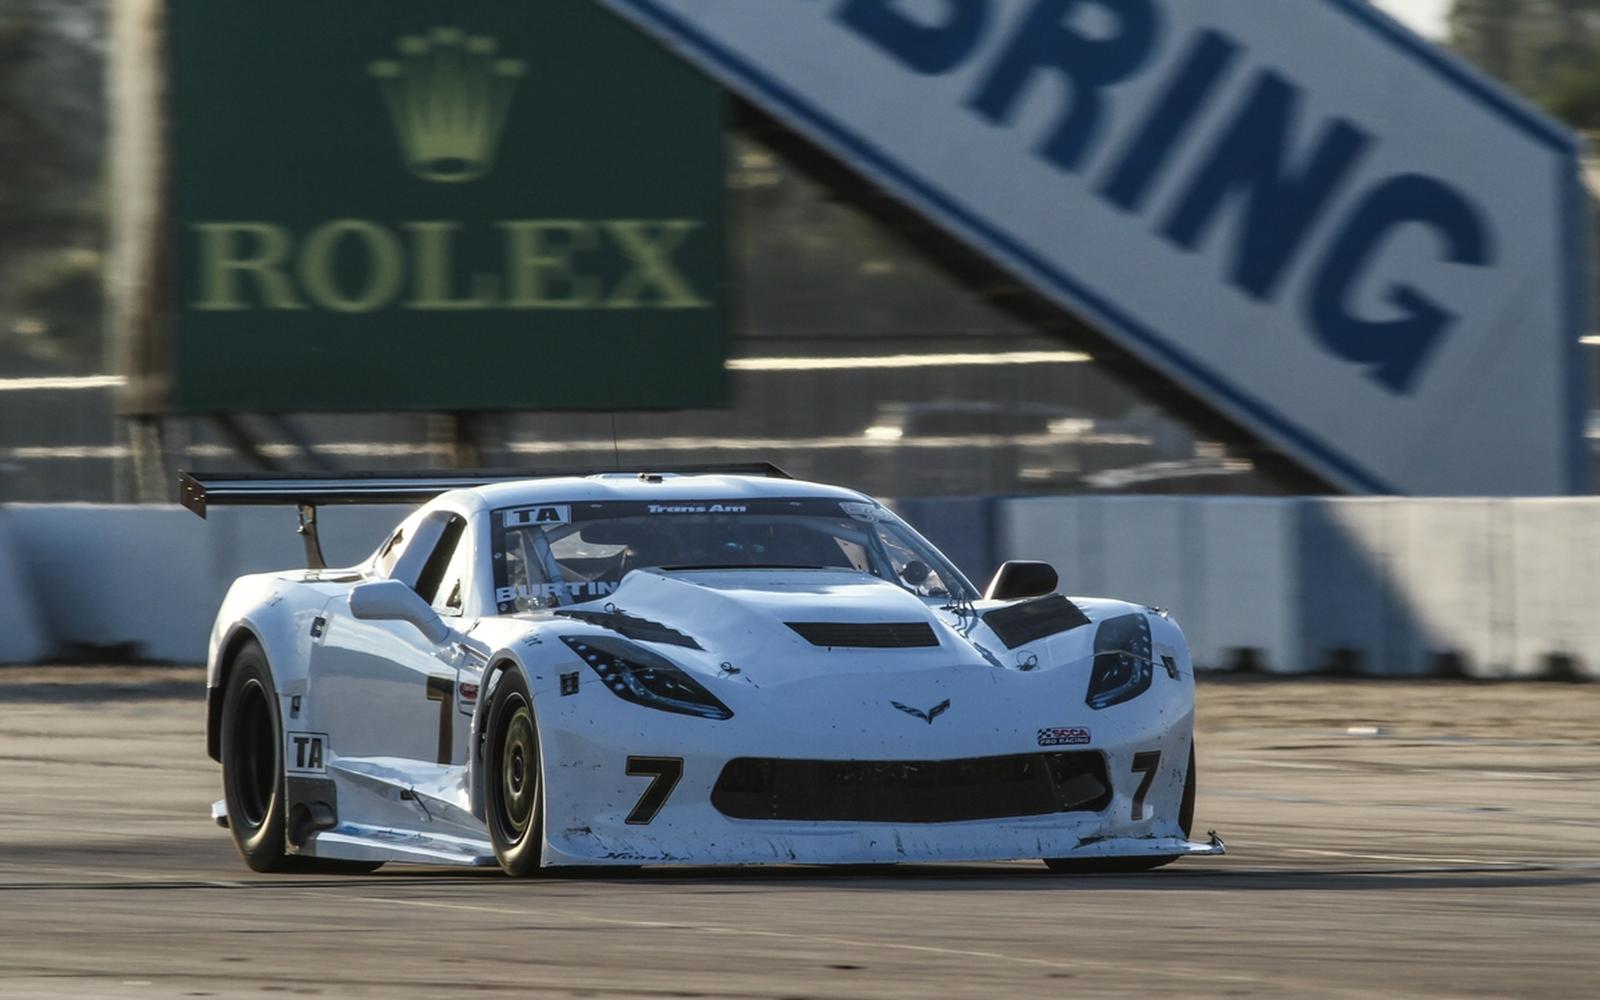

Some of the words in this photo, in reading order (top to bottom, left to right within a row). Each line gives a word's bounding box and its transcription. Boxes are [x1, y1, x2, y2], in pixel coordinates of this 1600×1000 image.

[190, 217, 711, 314] ROLEX
[513, 508, 560, 523] TA
[647, 504, 705, 513] Trans
[708, 504, 747, 513] Am
[496, 581, 617, 603] BURTIN
[1052, 729, 1089, 737] SCCA
[294, 737, 324, 768] TA
[625, 756, 683, 825] 7
[1131, 751, 1162, 821] 7
